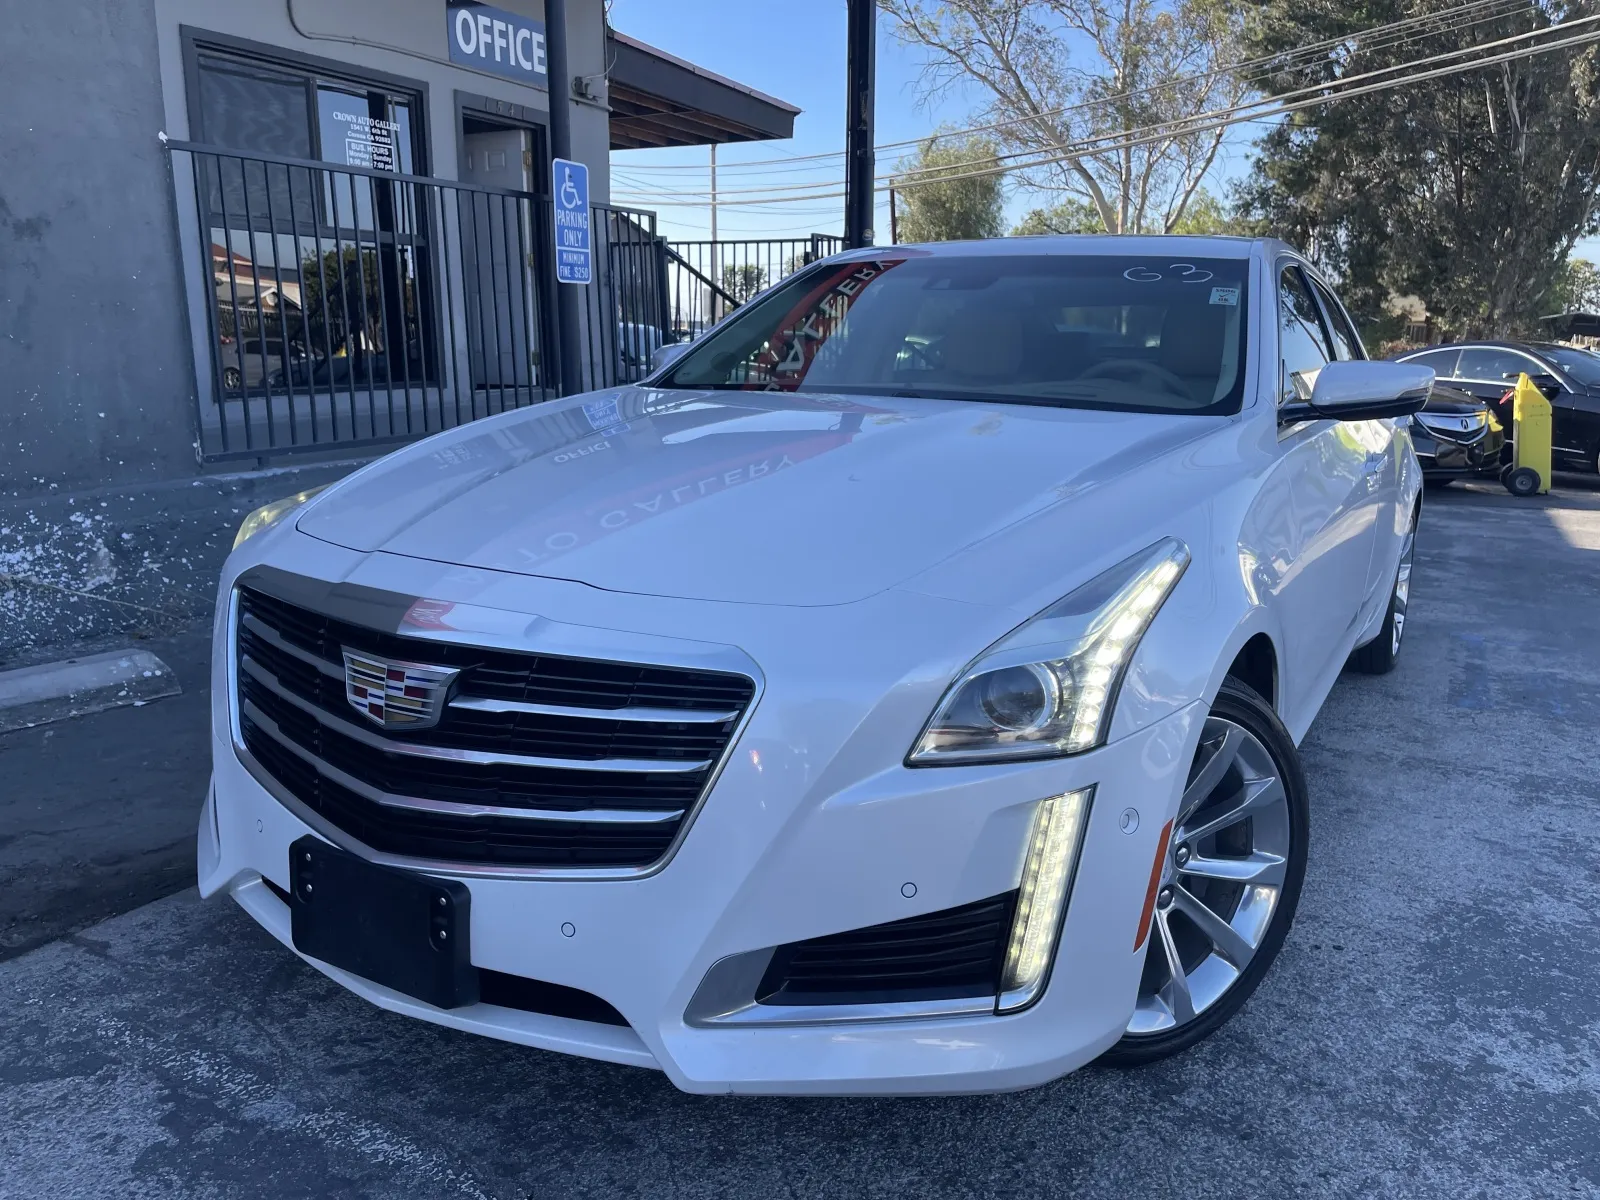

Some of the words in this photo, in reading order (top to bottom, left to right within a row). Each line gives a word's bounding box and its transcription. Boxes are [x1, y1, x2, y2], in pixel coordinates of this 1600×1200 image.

[455, 9, 547, 74] OFFICE
[484, 96, 526, 120] 1541
[333, 111, 357, 123] CROWN
[358, 116, 374, 127] AUTO
[375, 119, 400, 131] GALLERY
[349, 149, 370, 160] Monday
[373, 153, 392, 164] Sunday
[351, 142, 366, 151] BUS.
[367, 145, 389, 155] HOURS
[557, 209, 588, 229] PARKING
[564, 229, 582, 246] ONLY
[562, 251, 585, 265] MINIMUM
[560, 265, 571, 277] FINE
[573, 266, 589, 279] $250
